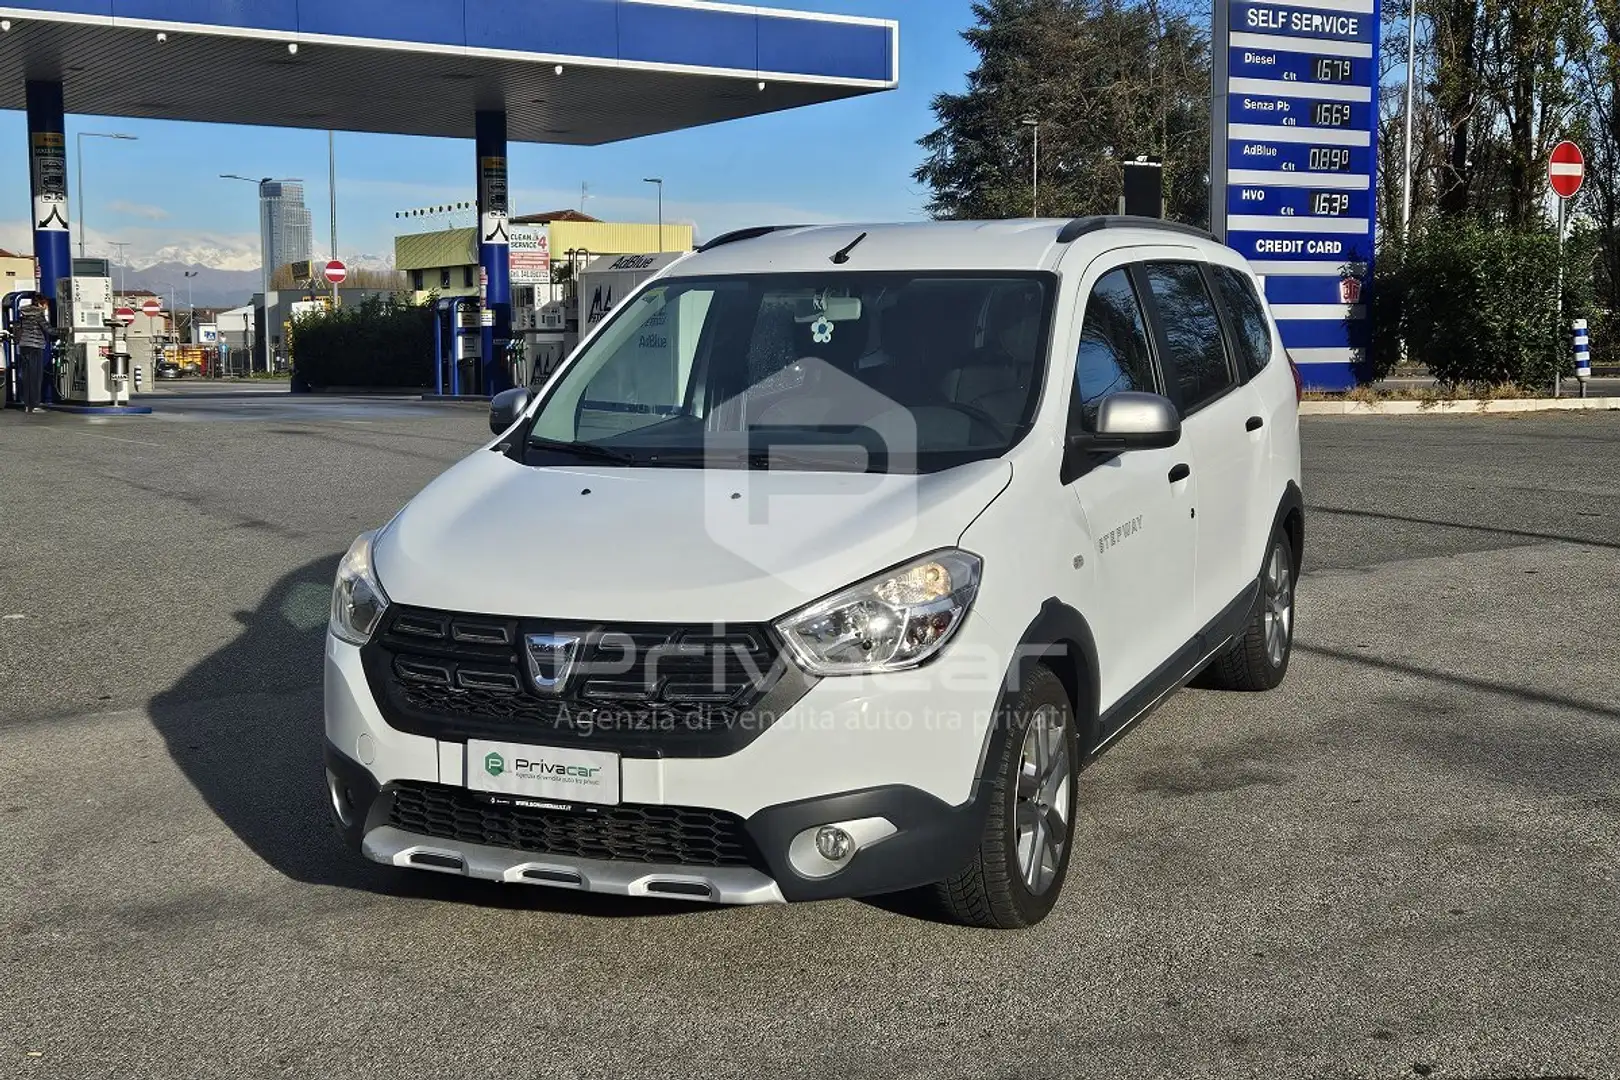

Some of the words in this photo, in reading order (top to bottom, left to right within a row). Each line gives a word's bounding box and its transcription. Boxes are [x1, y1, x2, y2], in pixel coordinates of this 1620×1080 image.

[1247, 8, 1287, 28] SELF
[1292, 12, 1358, 35] SERVICE
[1244, 52, 1276, 65] Diesel
[1244, 98, 1274, 111] Senza
[1277, 100, 1290, 111] Pb
[1243, 144, 1277, 157] AdBlue
[1241, 189, 1265, 201] HVO
[510, 233, 532, 241] CLEAN
[538, 236, 547, 249] 4
[1255, 239, 1304, 253] CREDIT
[1307, 240, 1342, 254] CARD
[608, 254, 654, 270] AdBlue
[1099, 514, 1143, 554] STEPWAY
[515, 758, 600, 778] Privacar
